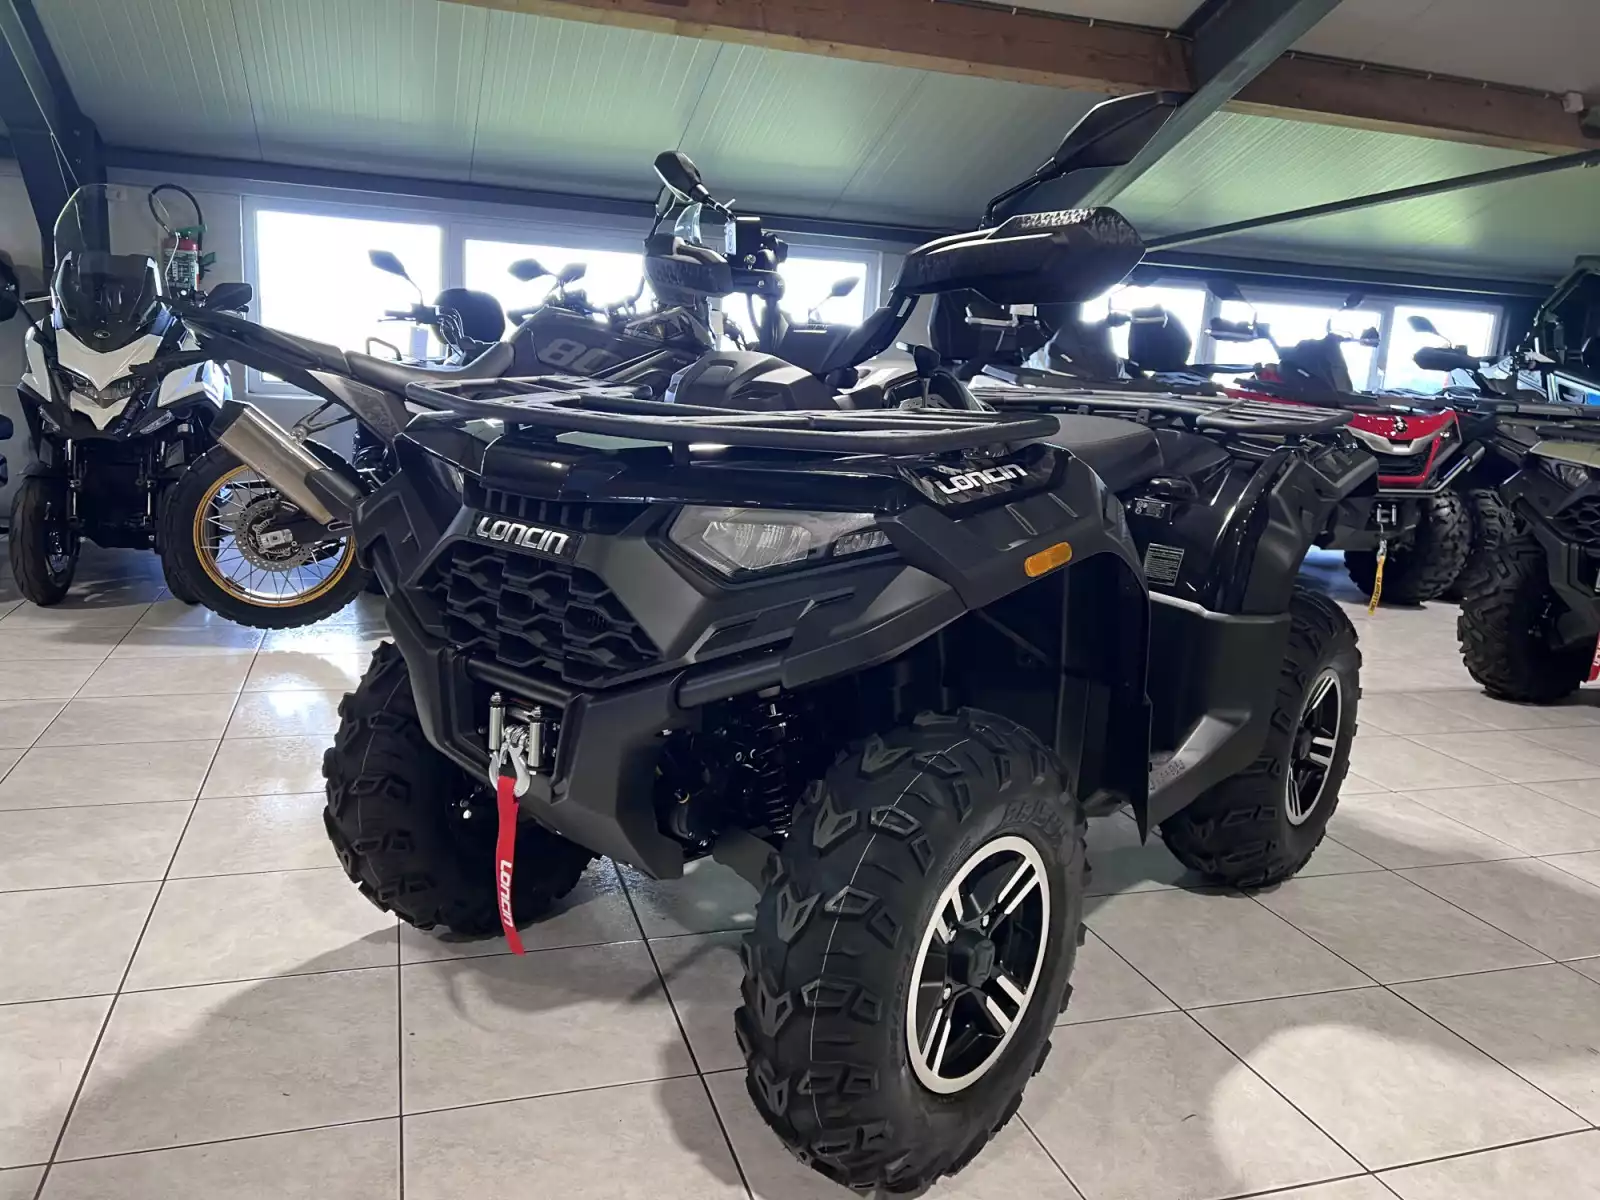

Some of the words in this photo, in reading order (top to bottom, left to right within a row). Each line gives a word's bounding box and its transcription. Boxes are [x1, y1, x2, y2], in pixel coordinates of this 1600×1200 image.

[935, 464, 1028, 494] LONCIN
[476, 517, 569, 554] LONCIN
[500, 859, 513, 928] LONCIN
